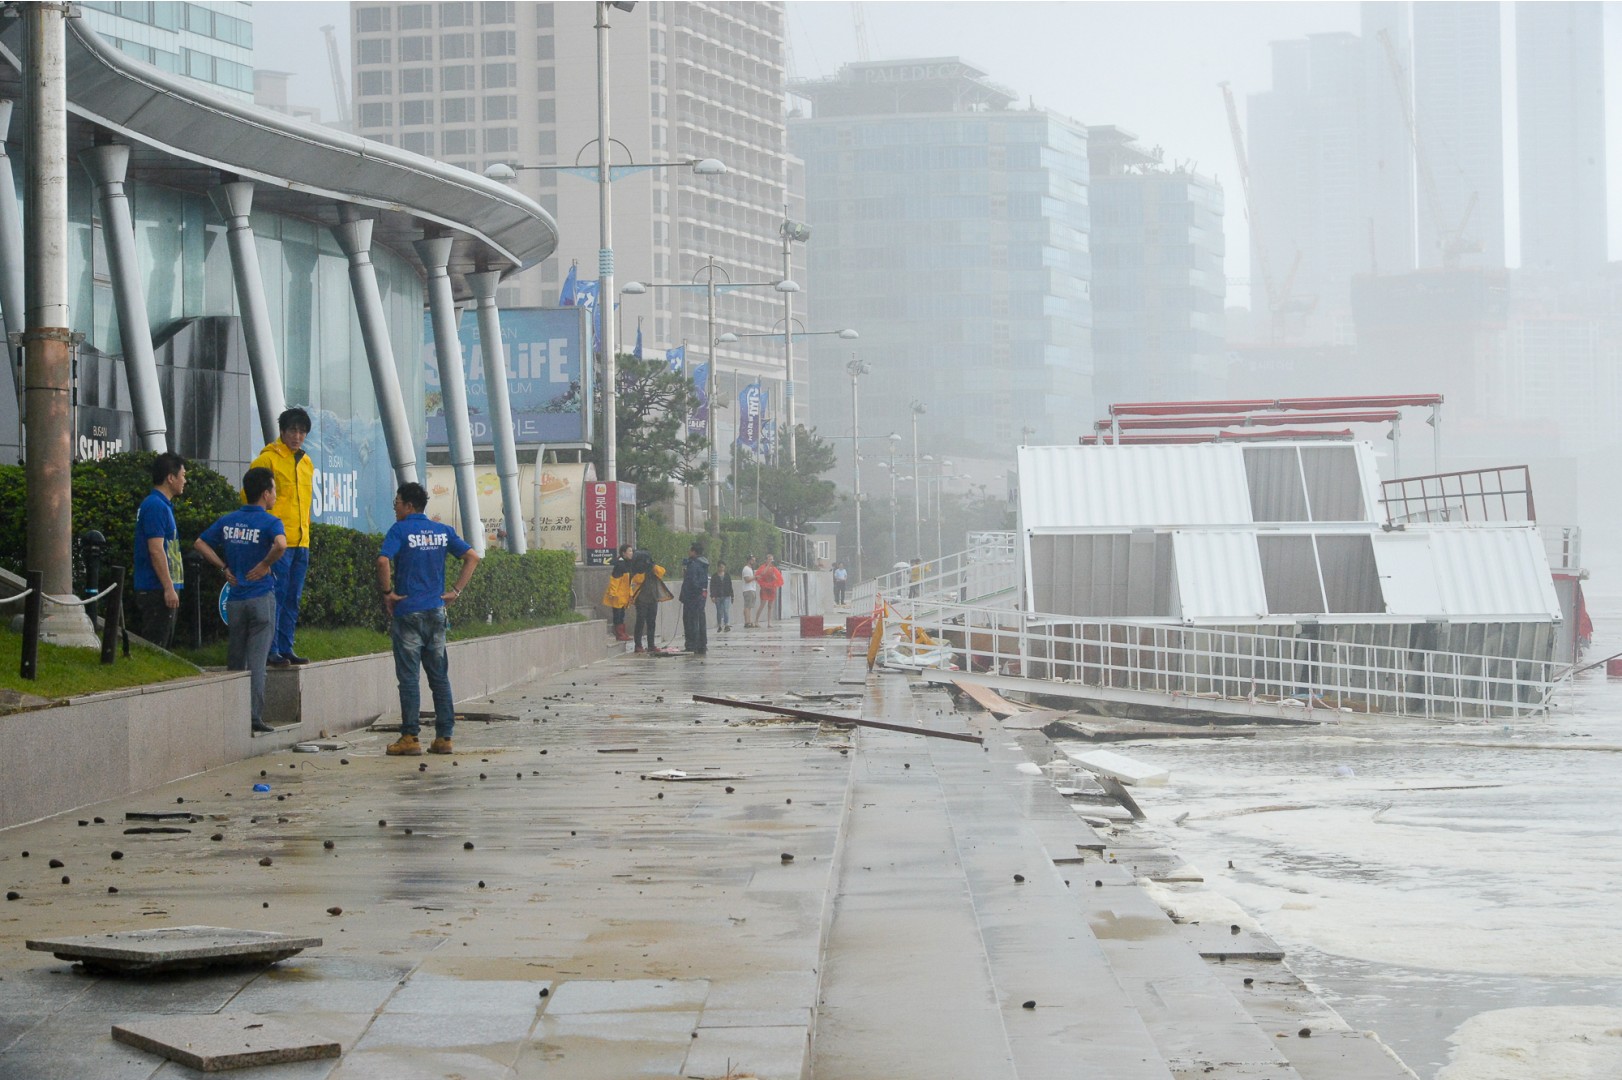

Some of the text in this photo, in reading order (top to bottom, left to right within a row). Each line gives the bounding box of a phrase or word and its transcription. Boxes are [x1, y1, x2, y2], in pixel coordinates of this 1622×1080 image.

[473, 327, 517, 339] BAN
[328, 455, 344, 468] BUSAN
[312, 468, 337, 517] SEA
[595, 496, 608, 548] 롯데리아
[223, 525, 240, 540] SEA
[408, 533, 428, 548] SEA
